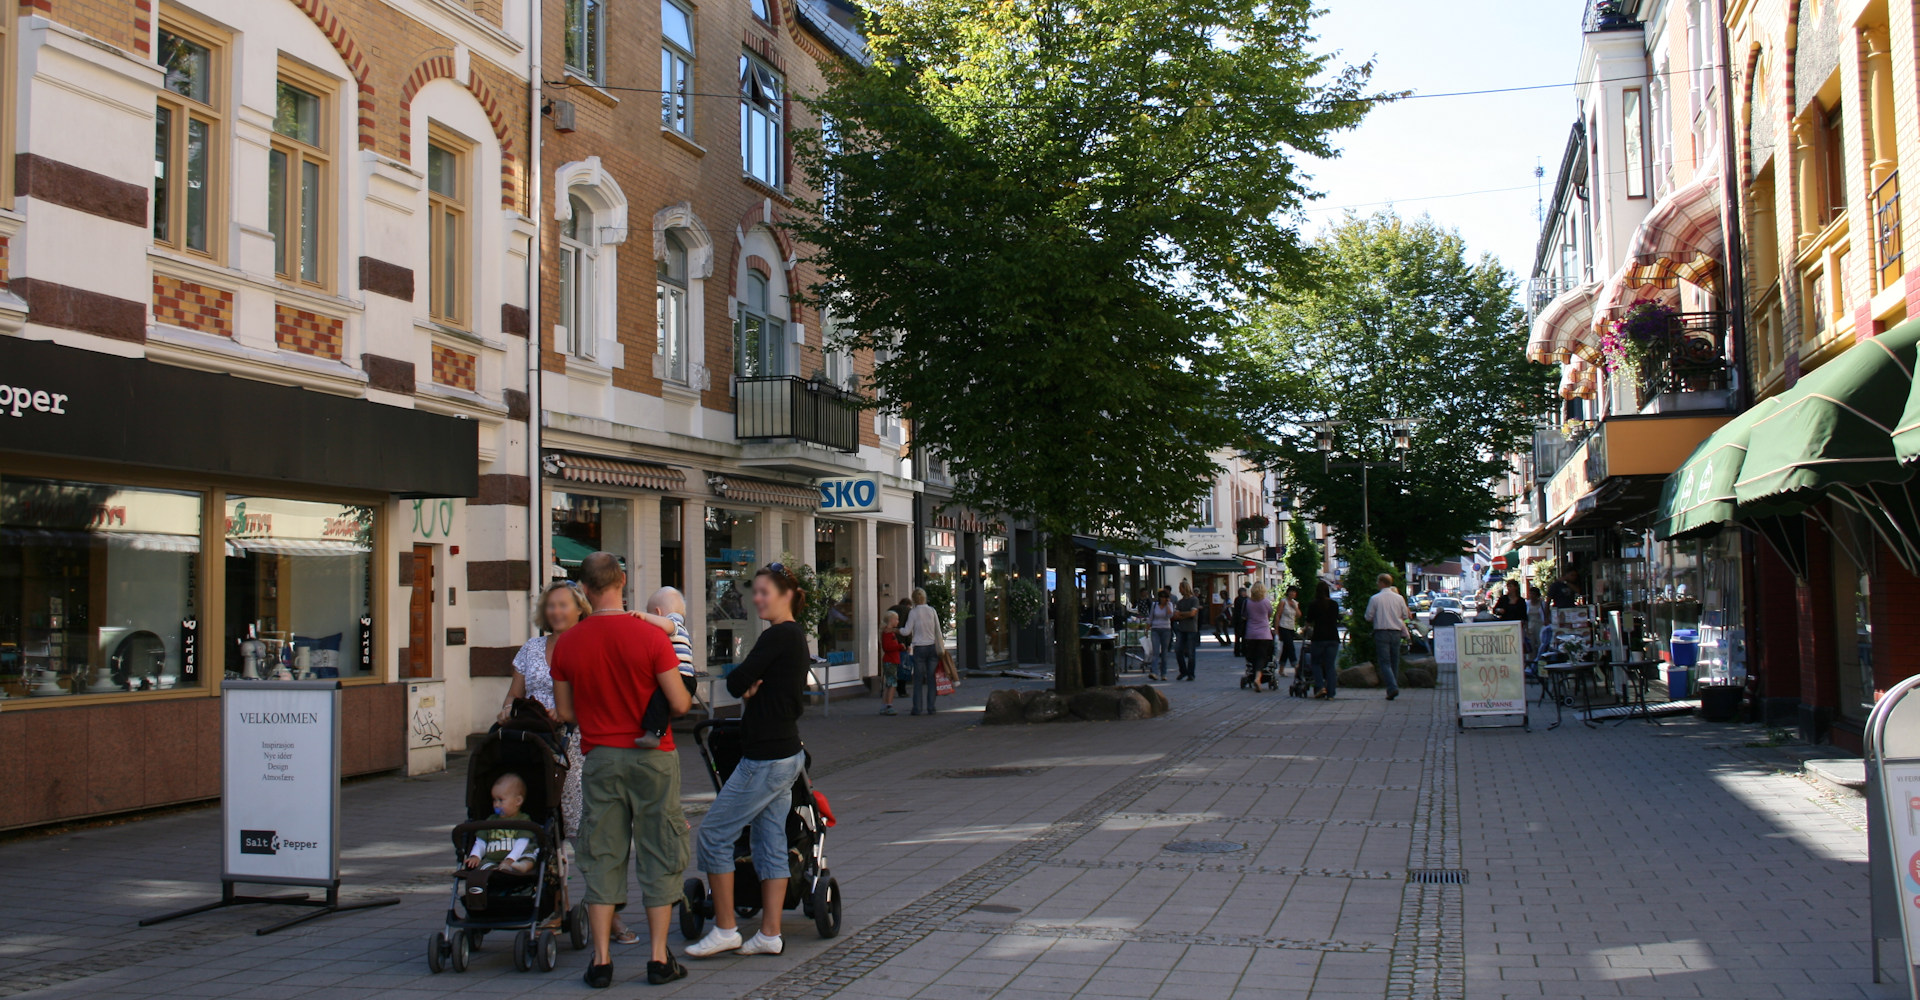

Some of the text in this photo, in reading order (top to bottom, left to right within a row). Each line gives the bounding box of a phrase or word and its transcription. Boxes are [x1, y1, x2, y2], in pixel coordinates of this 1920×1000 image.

[820, 480, 876, 508] SKO
[182, 614, 197, 630] &
[185, 635, 195, 674] Salt
[362, 630, 370, 664] Salt
[240, 712, 318, 724] VELKOMMEN
[262, 741, 295, 751] Inspirasjon
[263, 752, 276, 761] Nye
[267, 762, 289, 772] Design
[245, 835, 318, 851] Salt & Pepper
[486, 838, 515, 852] mil
